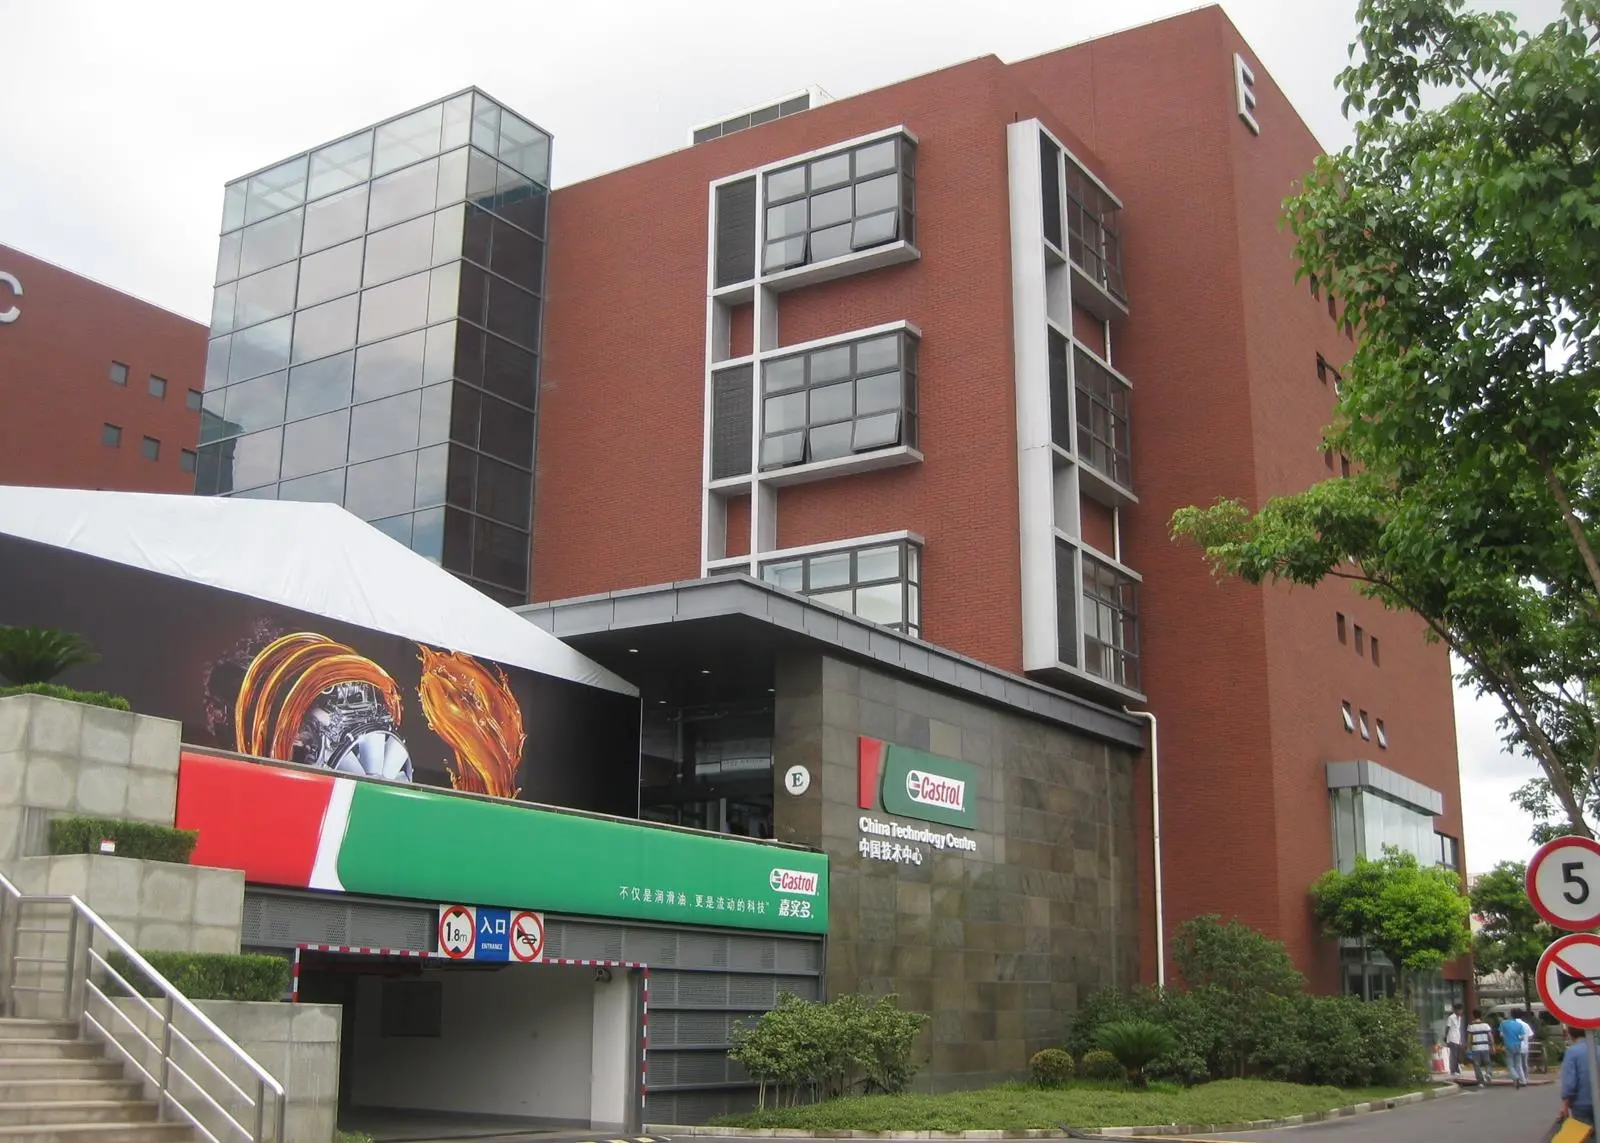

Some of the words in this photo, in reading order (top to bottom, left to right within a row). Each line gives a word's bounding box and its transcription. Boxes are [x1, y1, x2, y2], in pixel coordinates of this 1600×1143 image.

[1232, 52, 1260, 136] E
[791, 772, 804, 787] E
[920, 776, 961, 806] Castrol
[859, 817, 890, 836] China
[889, 822, 946, 850] Technology
[945, 833, 977, 852] Centre
[859, 838, 923, 866] 中国技术中心
[781, 872, 815, 892] Castrol
[1562, 861, 1590, 905] 5
[778, 899, 811, 918] 嘉实多
[446, 921, 468, 942] 1.8m
[480, 916, 506, 935] 入口
[481, 942, 503, 951] ENTRANCE
